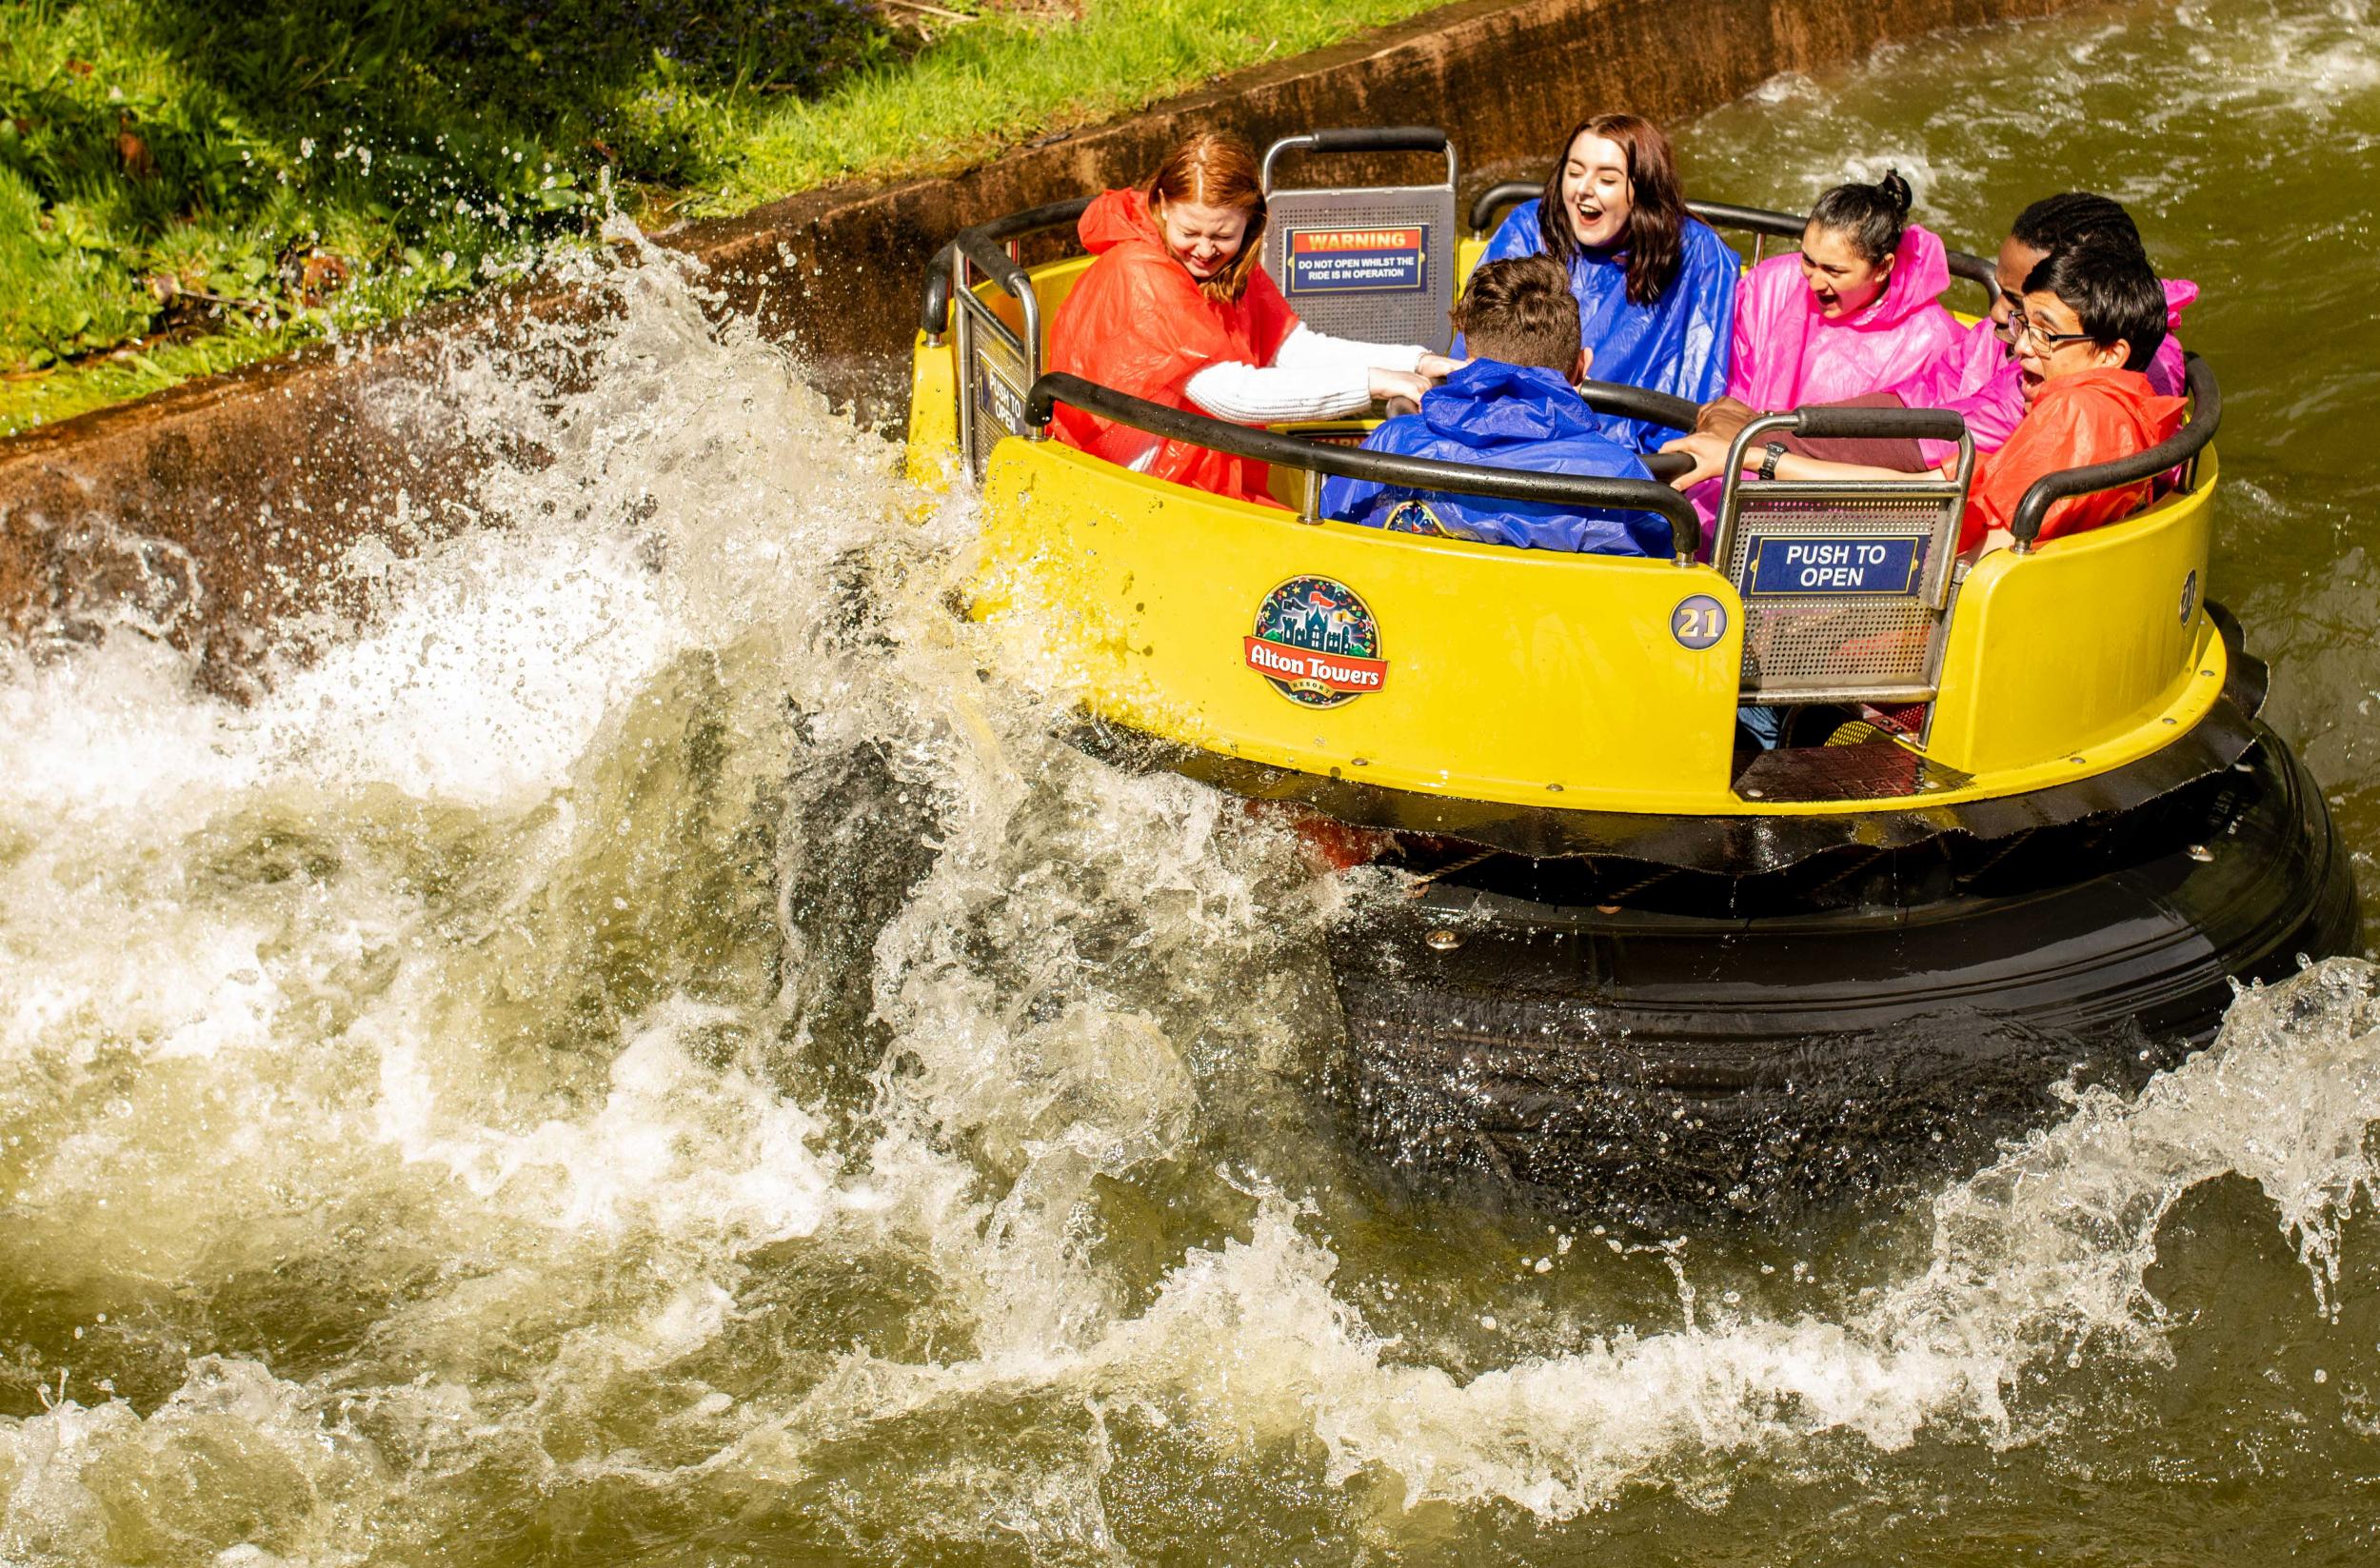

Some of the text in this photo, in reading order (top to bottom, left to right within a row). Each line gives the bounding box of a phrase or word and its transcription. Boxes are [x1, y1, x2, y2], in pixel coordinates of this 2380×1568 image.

[1309, 232, 1406, 250] WARNING
[1299, 256, 1414, 269] DO NOT OPEN WHILST THE
[1308, 268, 1404, 280] RIDE IS IN OPERATION
[989, 369, 1021, 419] PUSH TO
[995, 400, 1017, 435] OPEN
[1786, 546, 1886, 565] PUSH TO
[1800, 567, 1864, 586] OPEN
[1677, 607, 1719, 638] 21
[1250, 644, 1379, 685] Alton Towers
[1292, 681, 1331, 694] RESORT
